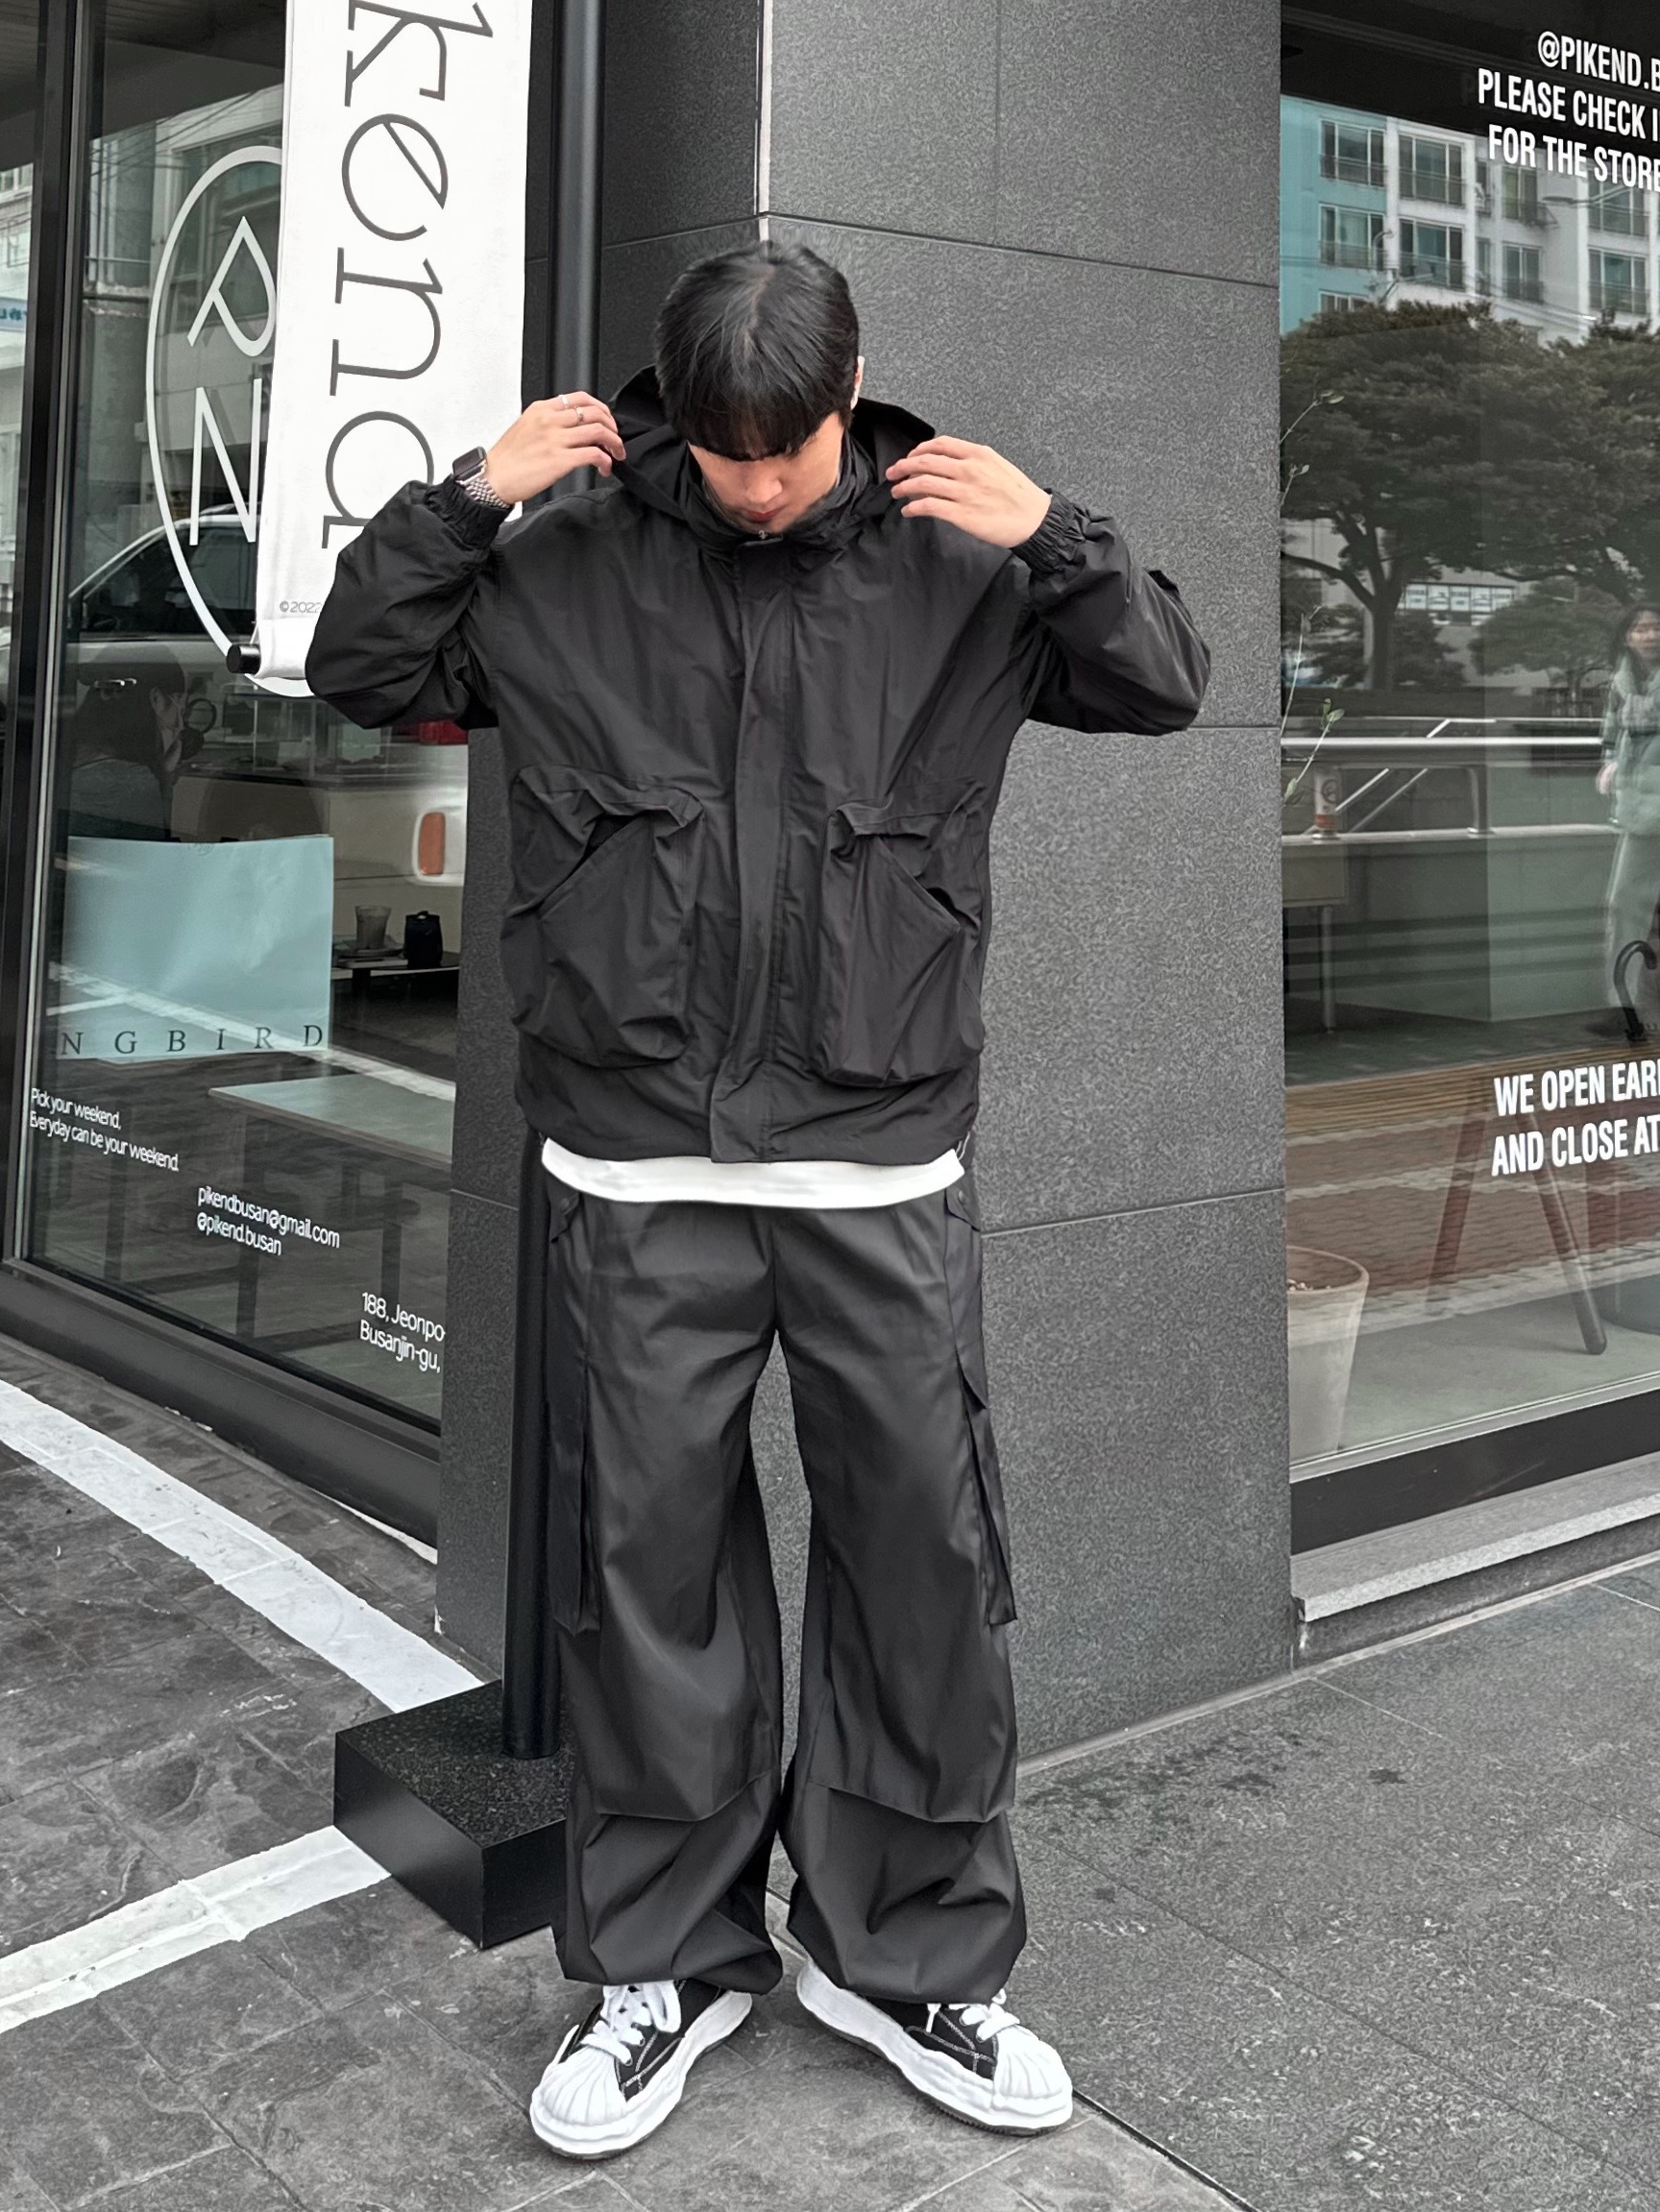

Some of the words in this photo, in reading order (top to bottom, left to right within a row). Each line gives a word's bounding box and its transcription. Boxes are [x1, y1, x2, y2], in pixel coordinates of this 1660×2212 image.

[1478, 67, 1567, 122] PLEASE
[1573, 89, 1647, 139] CHECK
[1489, 123, 1536, 168] FOR
[1542, 134, 1588, 179] THE
[31, 1087, 50, 1108] Pick
[50, 1097, 73, 1115] your
[1494, 1073, 1534, 1117] WE
[1541, 1064, 1605, 1111] OPEN
[1612, 1058, 1660, 1102] EAR
[30, 1110, 71, 1142] Everyday
[71, 1126, 90, 1144] can
[90, 1128, 104, 1148] be
[104, 1134, 128, 1155] your
[1491, 1130, 1545, 1177] AND
[1551, 1118, 1628, 1168] CLOSE
[1634, 1113, 1660, 1155] AT
[197, 1211, 281, 1256] @pikend.busan
[198, 1185, 340, 1249] pikendbusan@gmail.com
[362, 1292, 389, 1323] 188,
[360, 1319, 441, 1373] Busanjin-gu,
